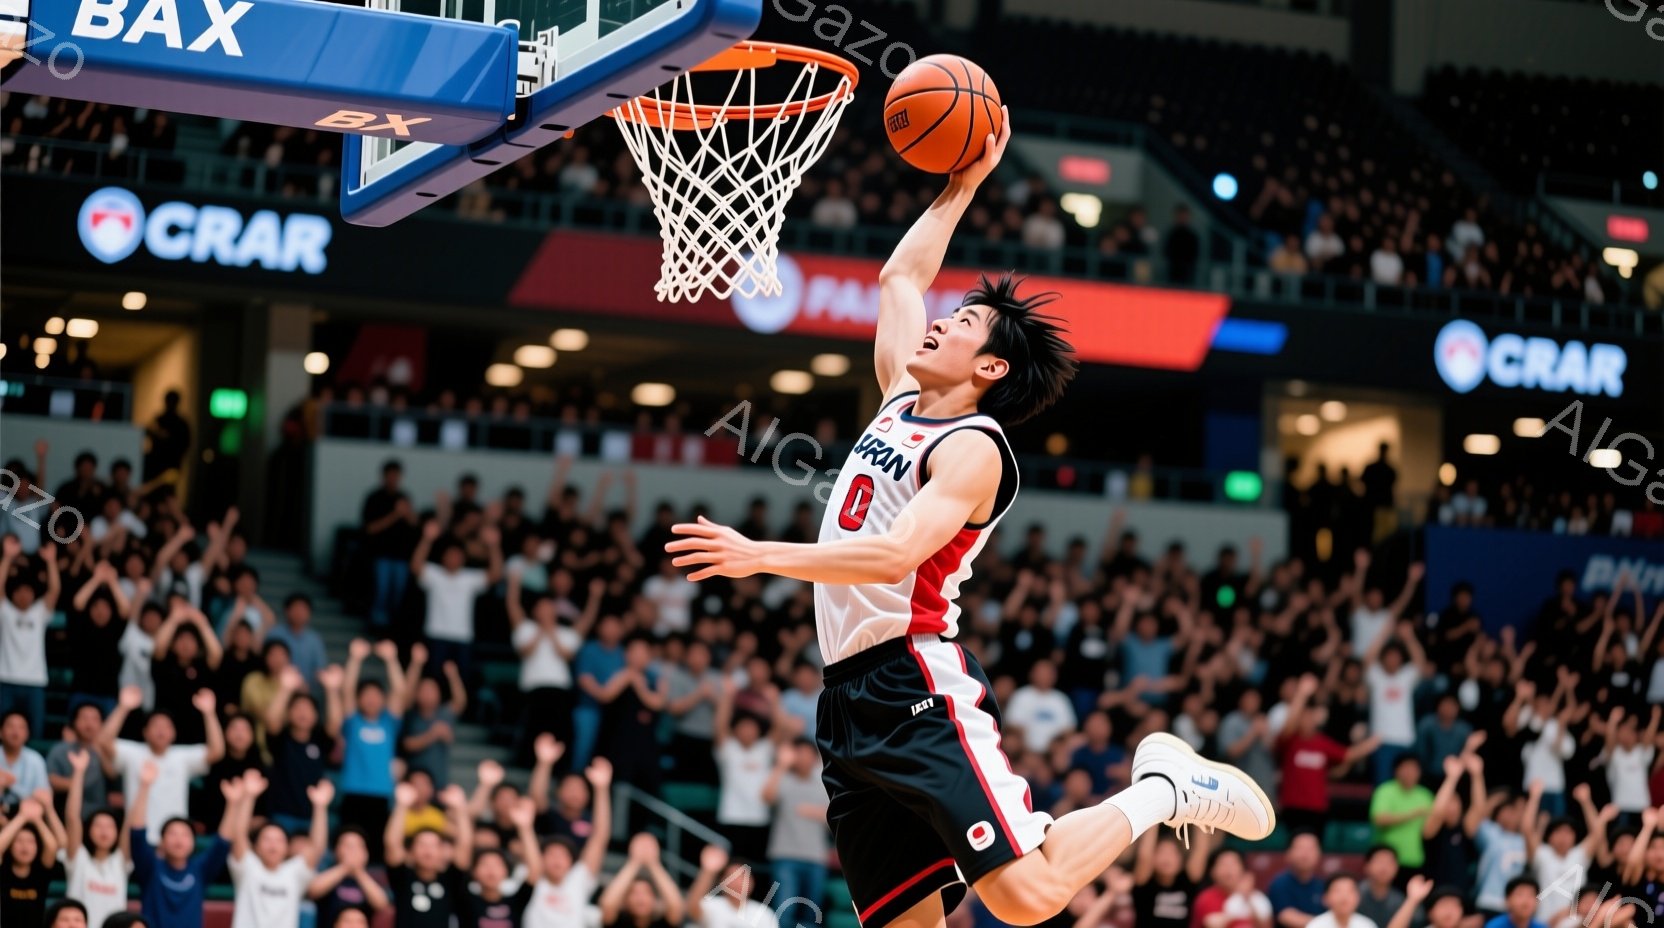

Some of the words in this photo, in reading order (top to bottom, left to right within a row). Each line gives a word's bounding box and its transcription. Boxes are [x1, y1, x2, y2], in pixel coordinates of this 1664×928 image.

[71, 0, 255, 57] BAX
[314, 110, 432, 136] BX
[145, 201, 332, 274] CRAR
[1488, 333, 1627, 397] CRAR
